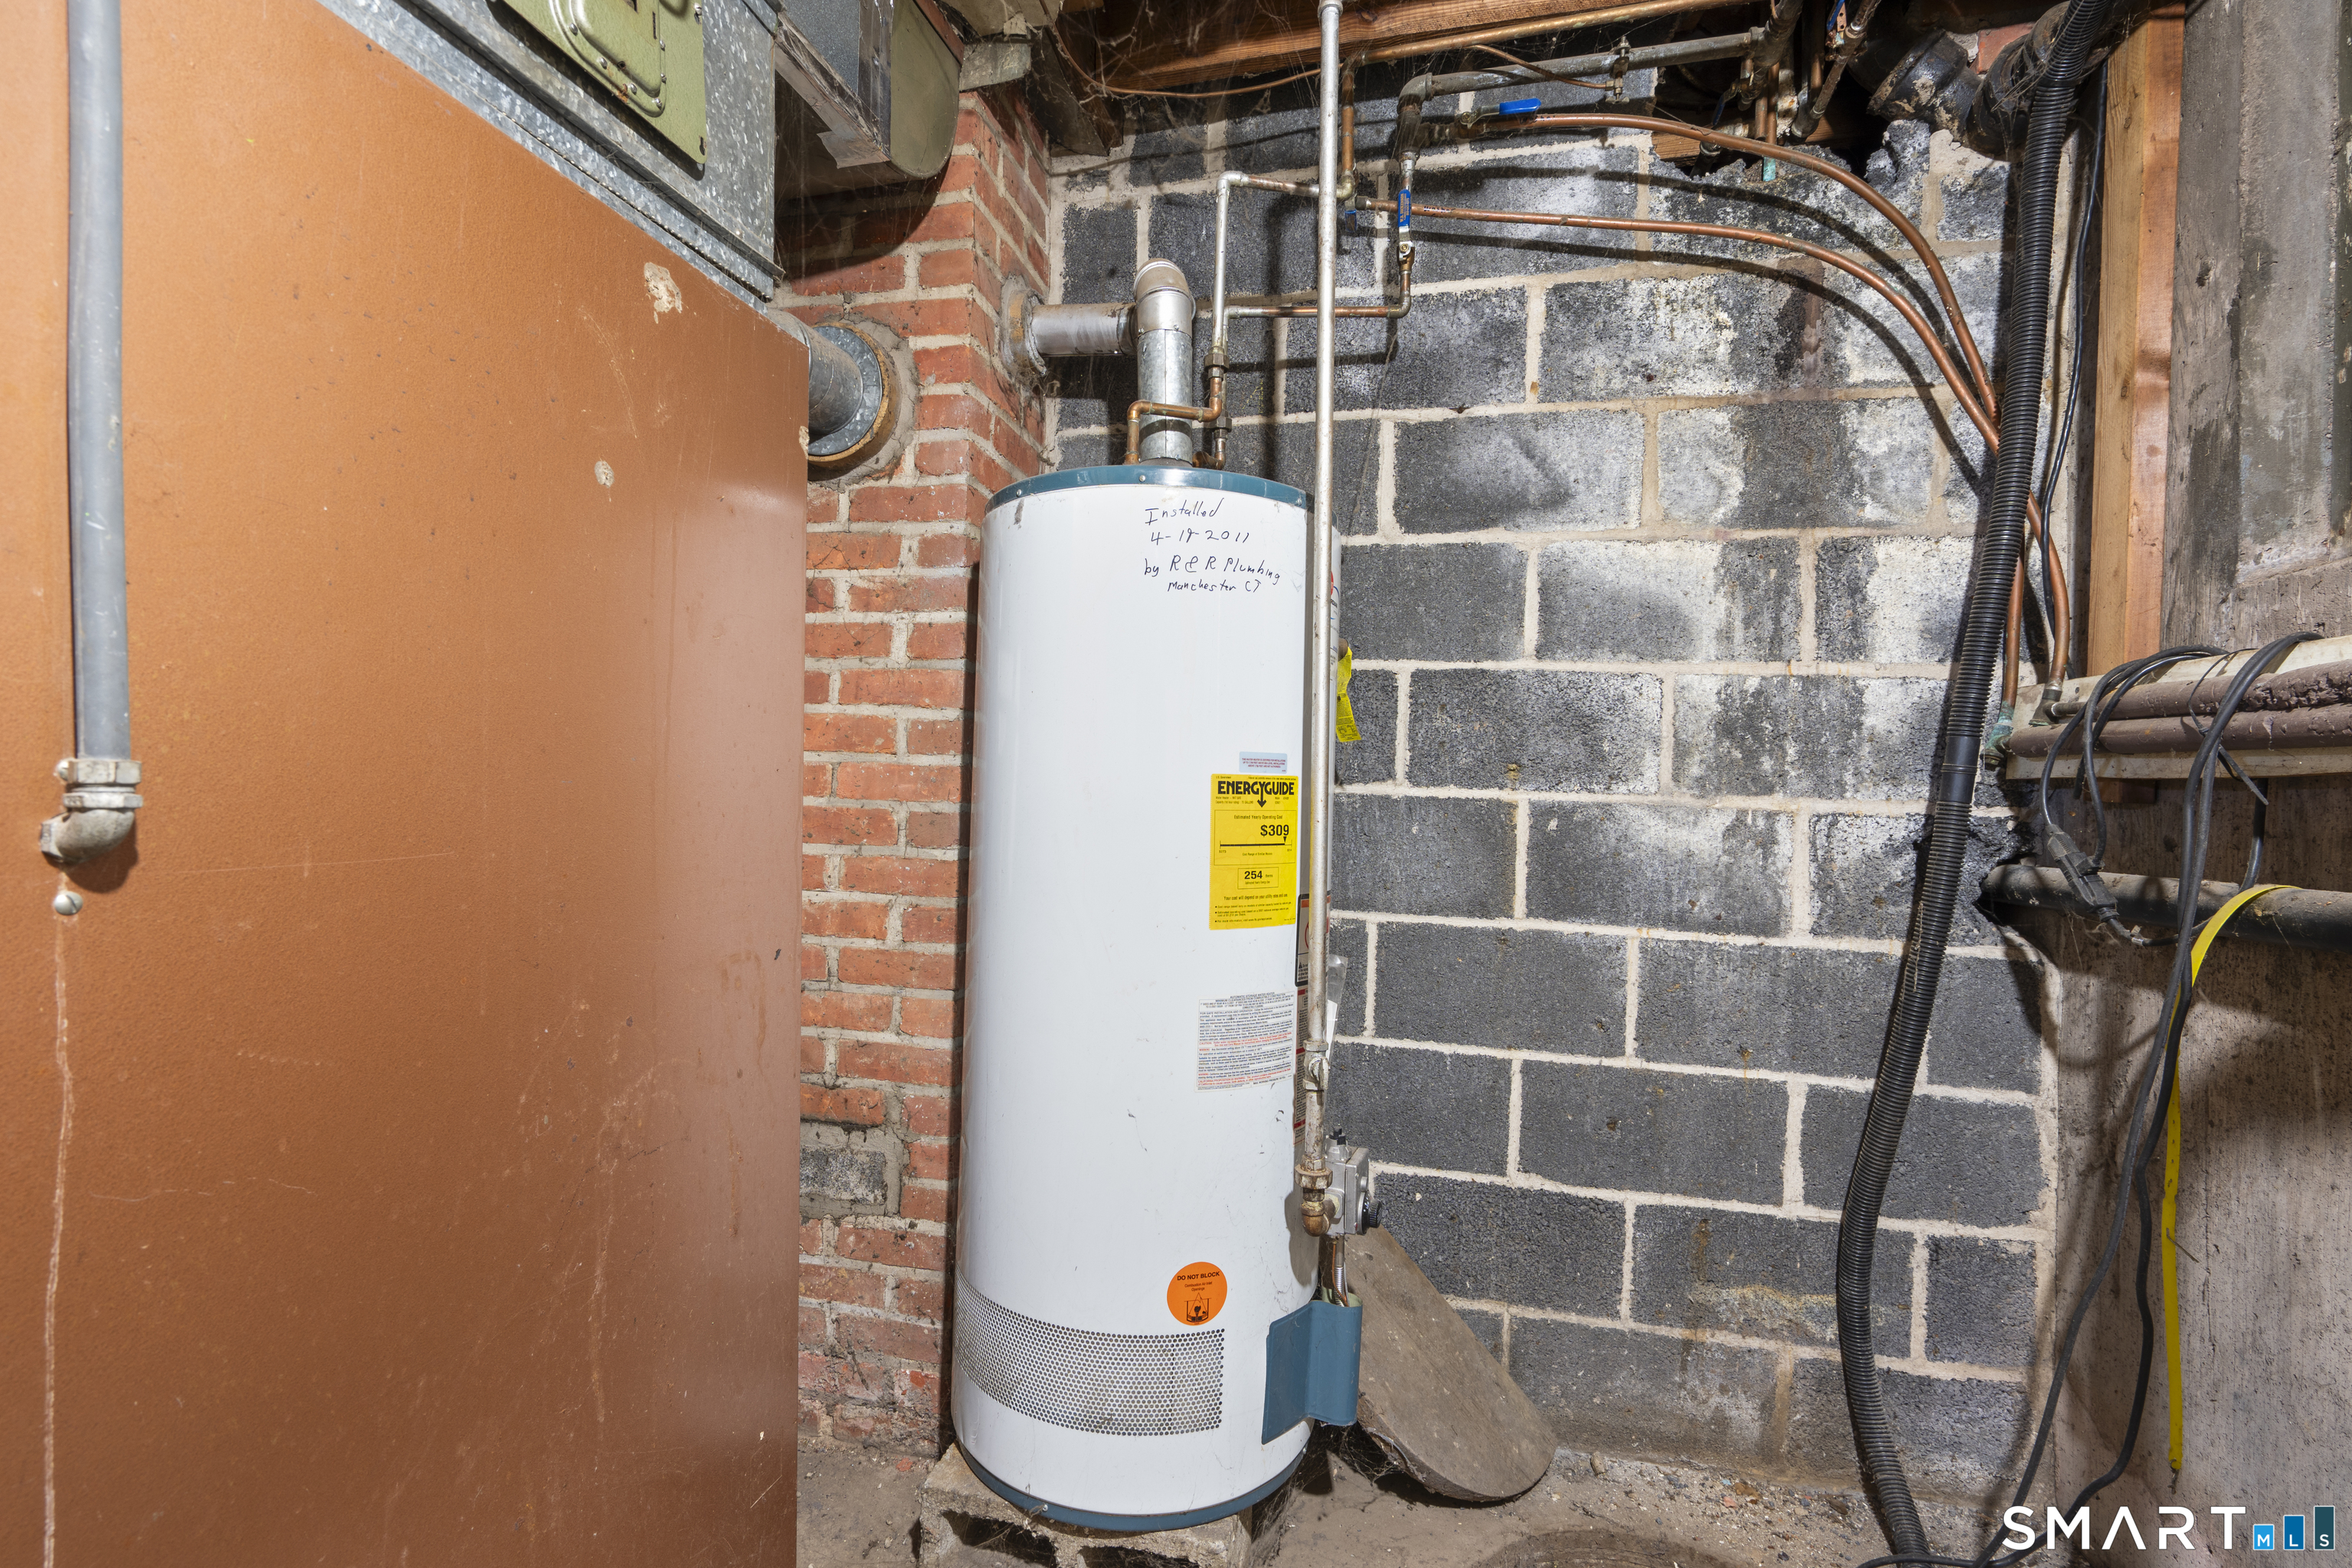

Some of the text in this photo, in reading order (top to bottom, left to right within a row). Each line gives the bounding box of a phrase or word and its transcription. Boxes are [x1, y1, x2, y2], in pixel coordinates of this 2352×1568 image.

[1145, 498, 1224, 525] Installed
[1145, 558, 1159, 577] by
[1169, 555, 1181, 572] R
[1205, 556, 1216, 570] R
[1223, 557, 1280, 585] Plumbing
[1167, 579, 1236, 592] Manchester
[1217, 780, 1294, 795] ENERGYGUIDE
[1260, 824, 1289, 837] $309
[1244, 871, 1263, 880] 254
